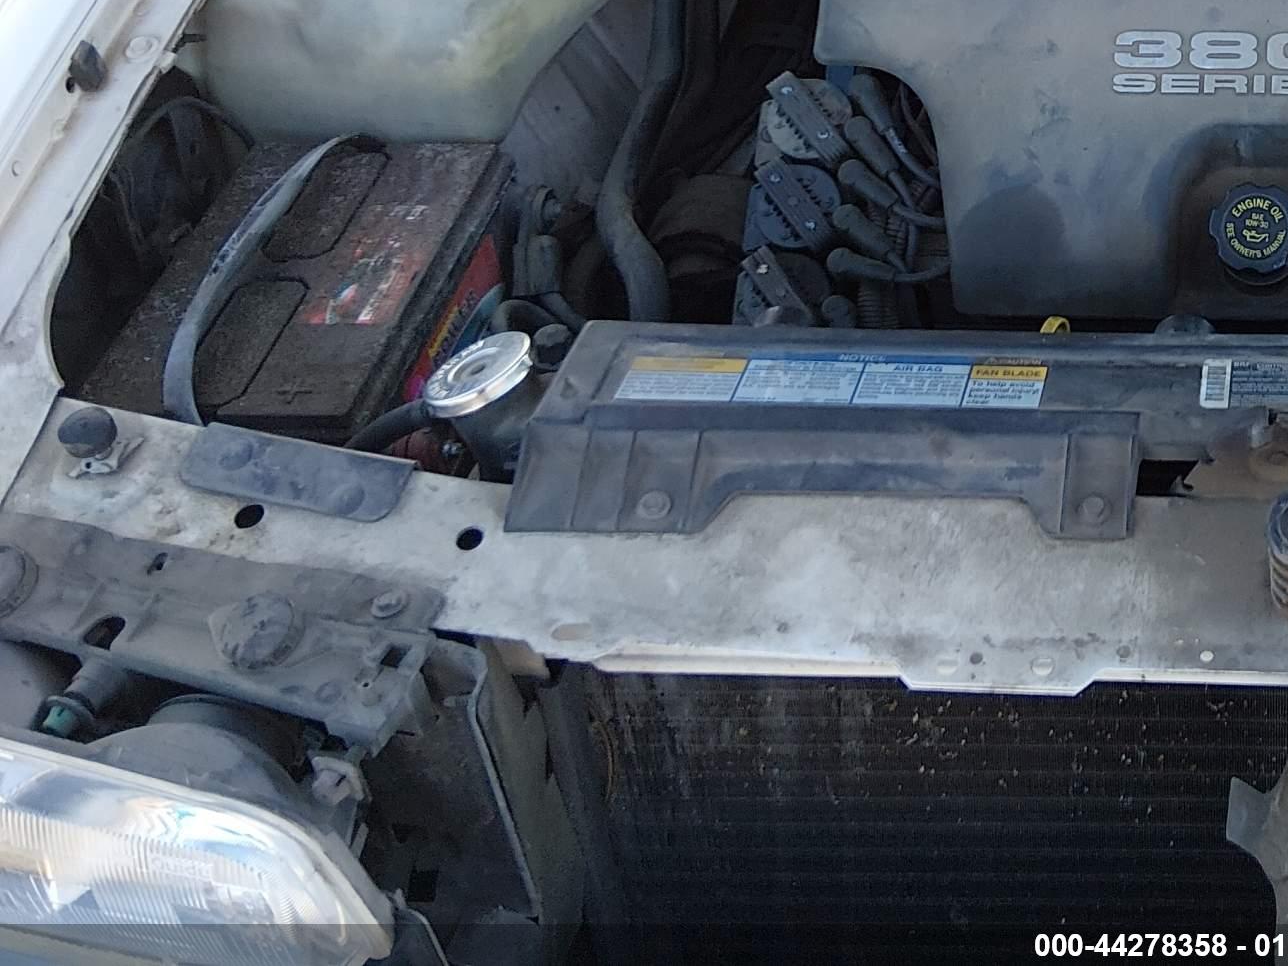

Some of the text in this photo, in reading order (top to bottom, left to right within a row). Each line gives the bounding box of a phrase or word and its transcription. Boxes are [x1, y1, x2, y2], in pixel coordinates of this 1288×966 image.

[1231, 198, 1285, 223] ENGINE OIL
[1226, 222, 1236, 238] SEE
[975, 369, 1042, 378] FAN BLADE
